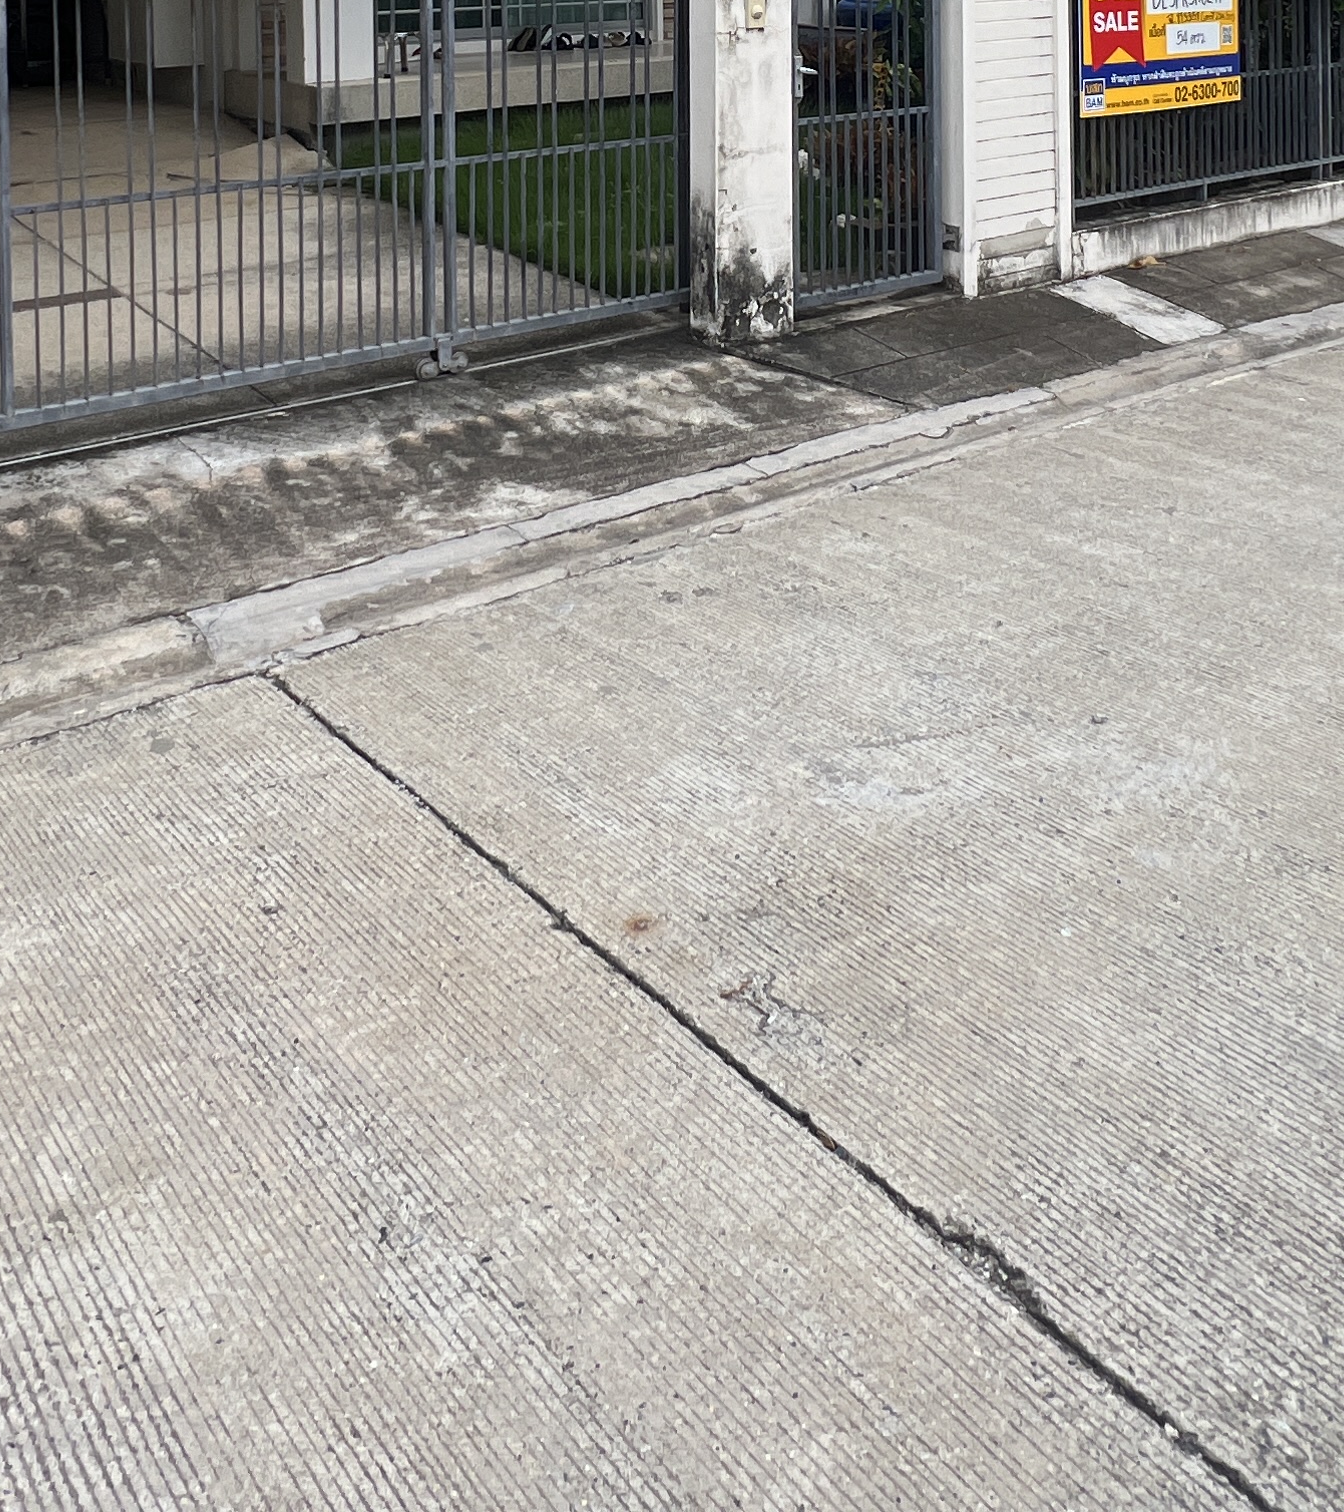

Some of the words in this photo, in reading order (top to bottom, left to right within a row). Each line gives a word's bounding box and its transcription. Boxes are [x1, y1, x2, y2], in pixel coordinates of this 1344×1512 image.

[1093, 10, 1139, 33] SALE
[1085, 96, 1103, 108] BAM
[1174, 80, 1240, 103] 02-6300-700
